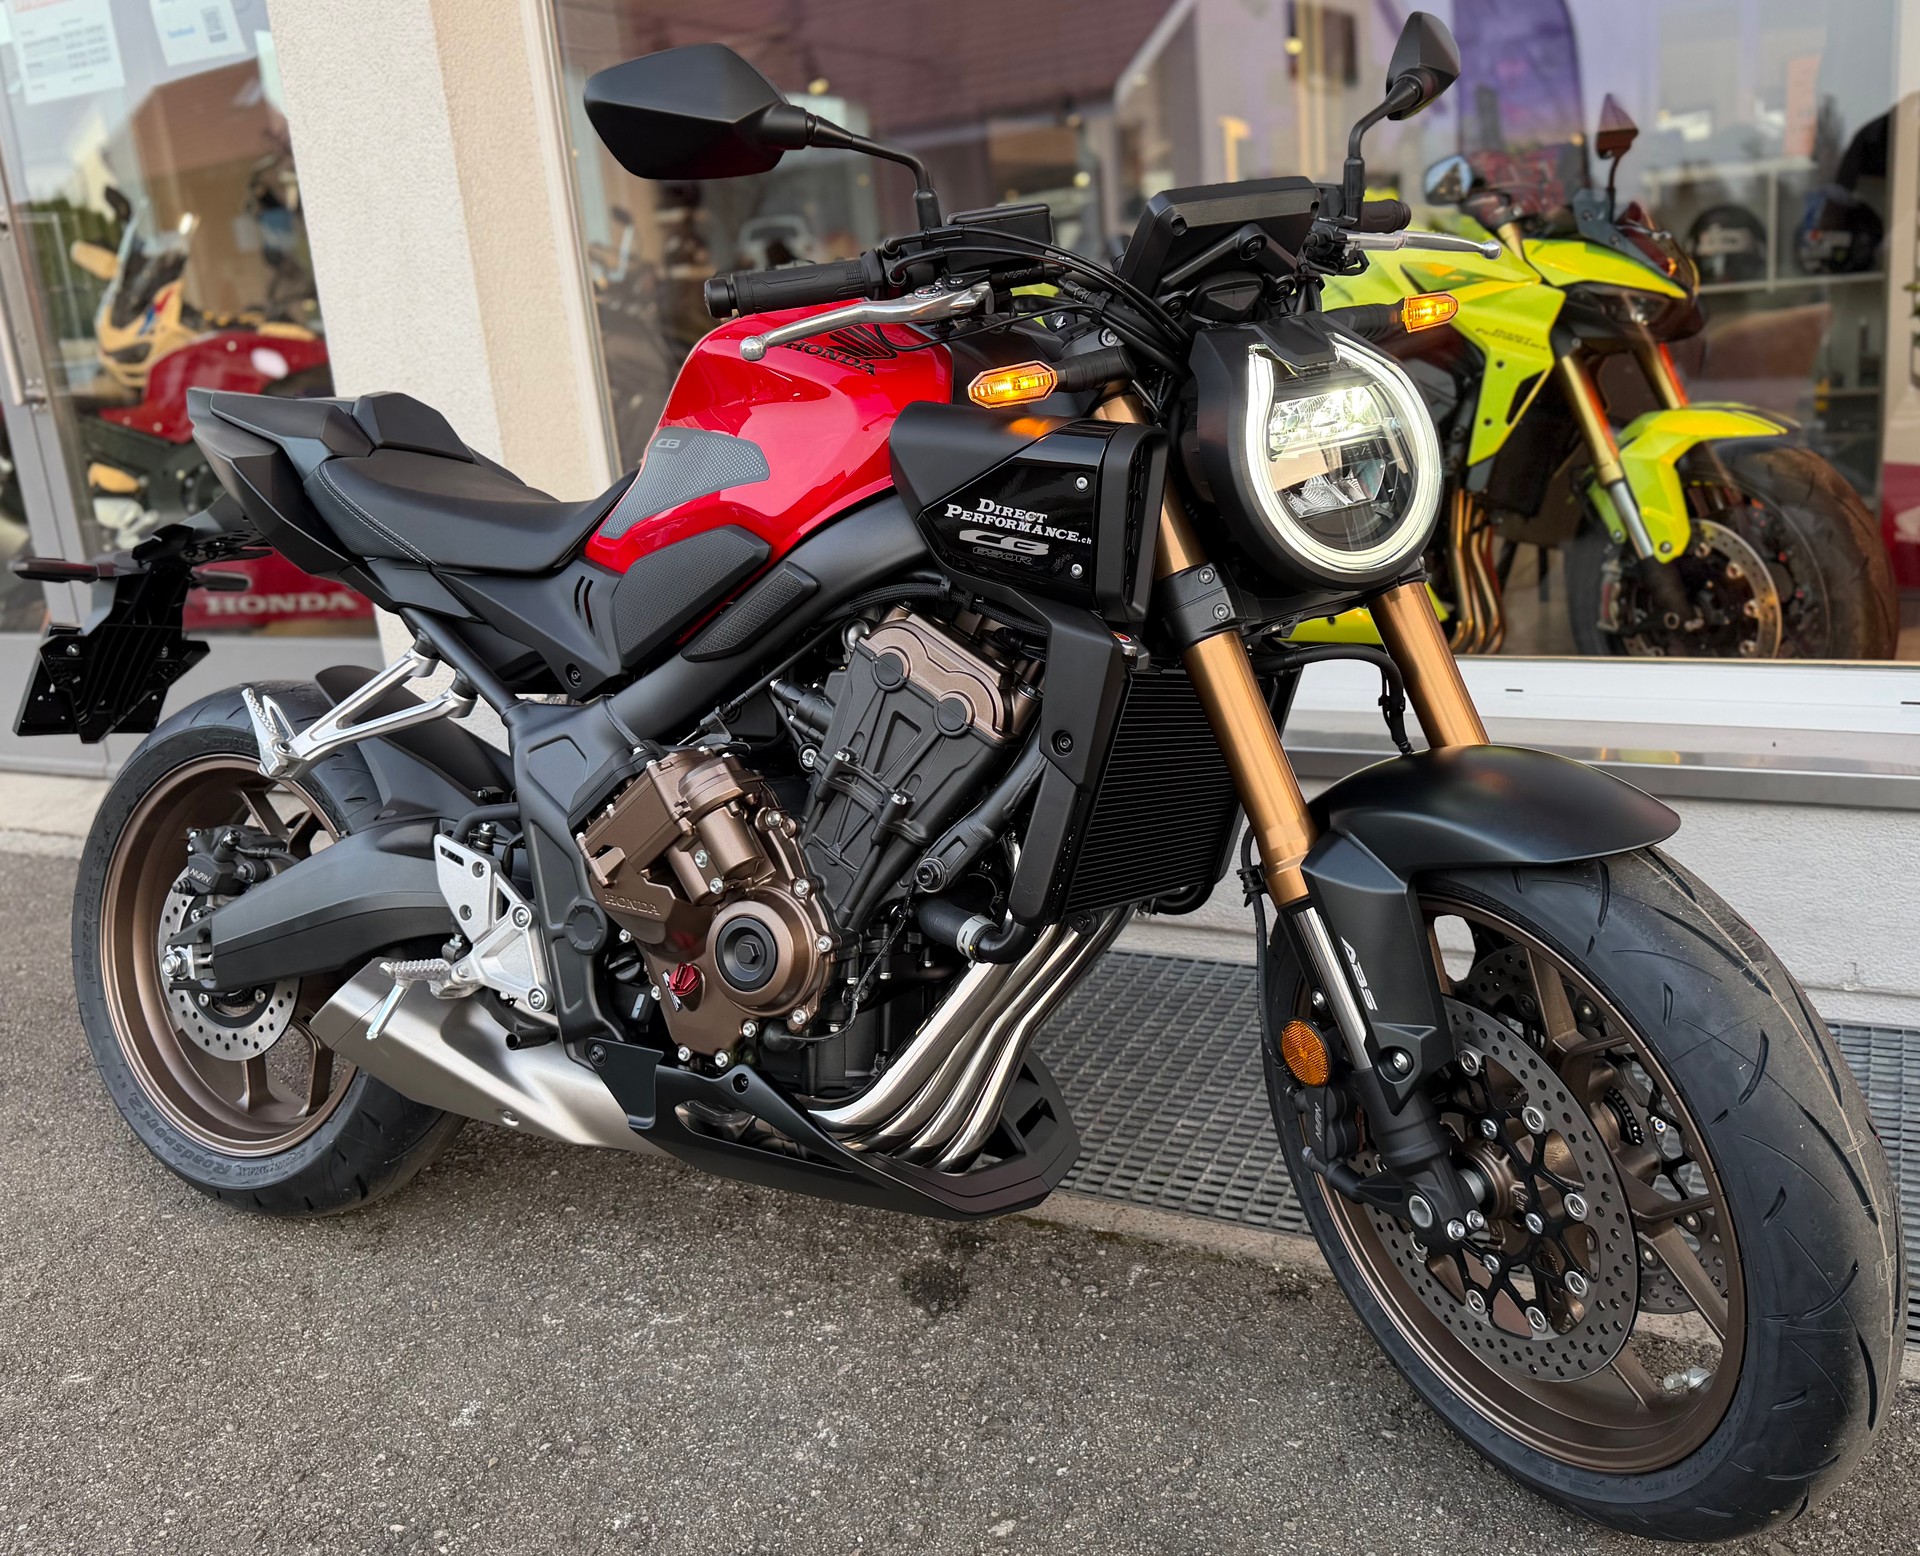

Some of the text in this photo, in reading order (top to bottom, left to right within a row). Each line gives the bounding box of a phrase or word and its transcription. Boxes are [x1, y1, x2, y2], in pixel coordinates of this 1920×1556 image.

[784, 341, 876, 376] HONDA
[655, 438, 681, 449] CB
[976, 498, 1048, 524] DIRECT
[959, 529, 1050, 556] CB
[972, 546, 1034, 566] 650R
[205, 591, 358, 616] HONDA
[605, 894, 661, 916] HONDA
[1340, 936, 1379, 1011] ABS
